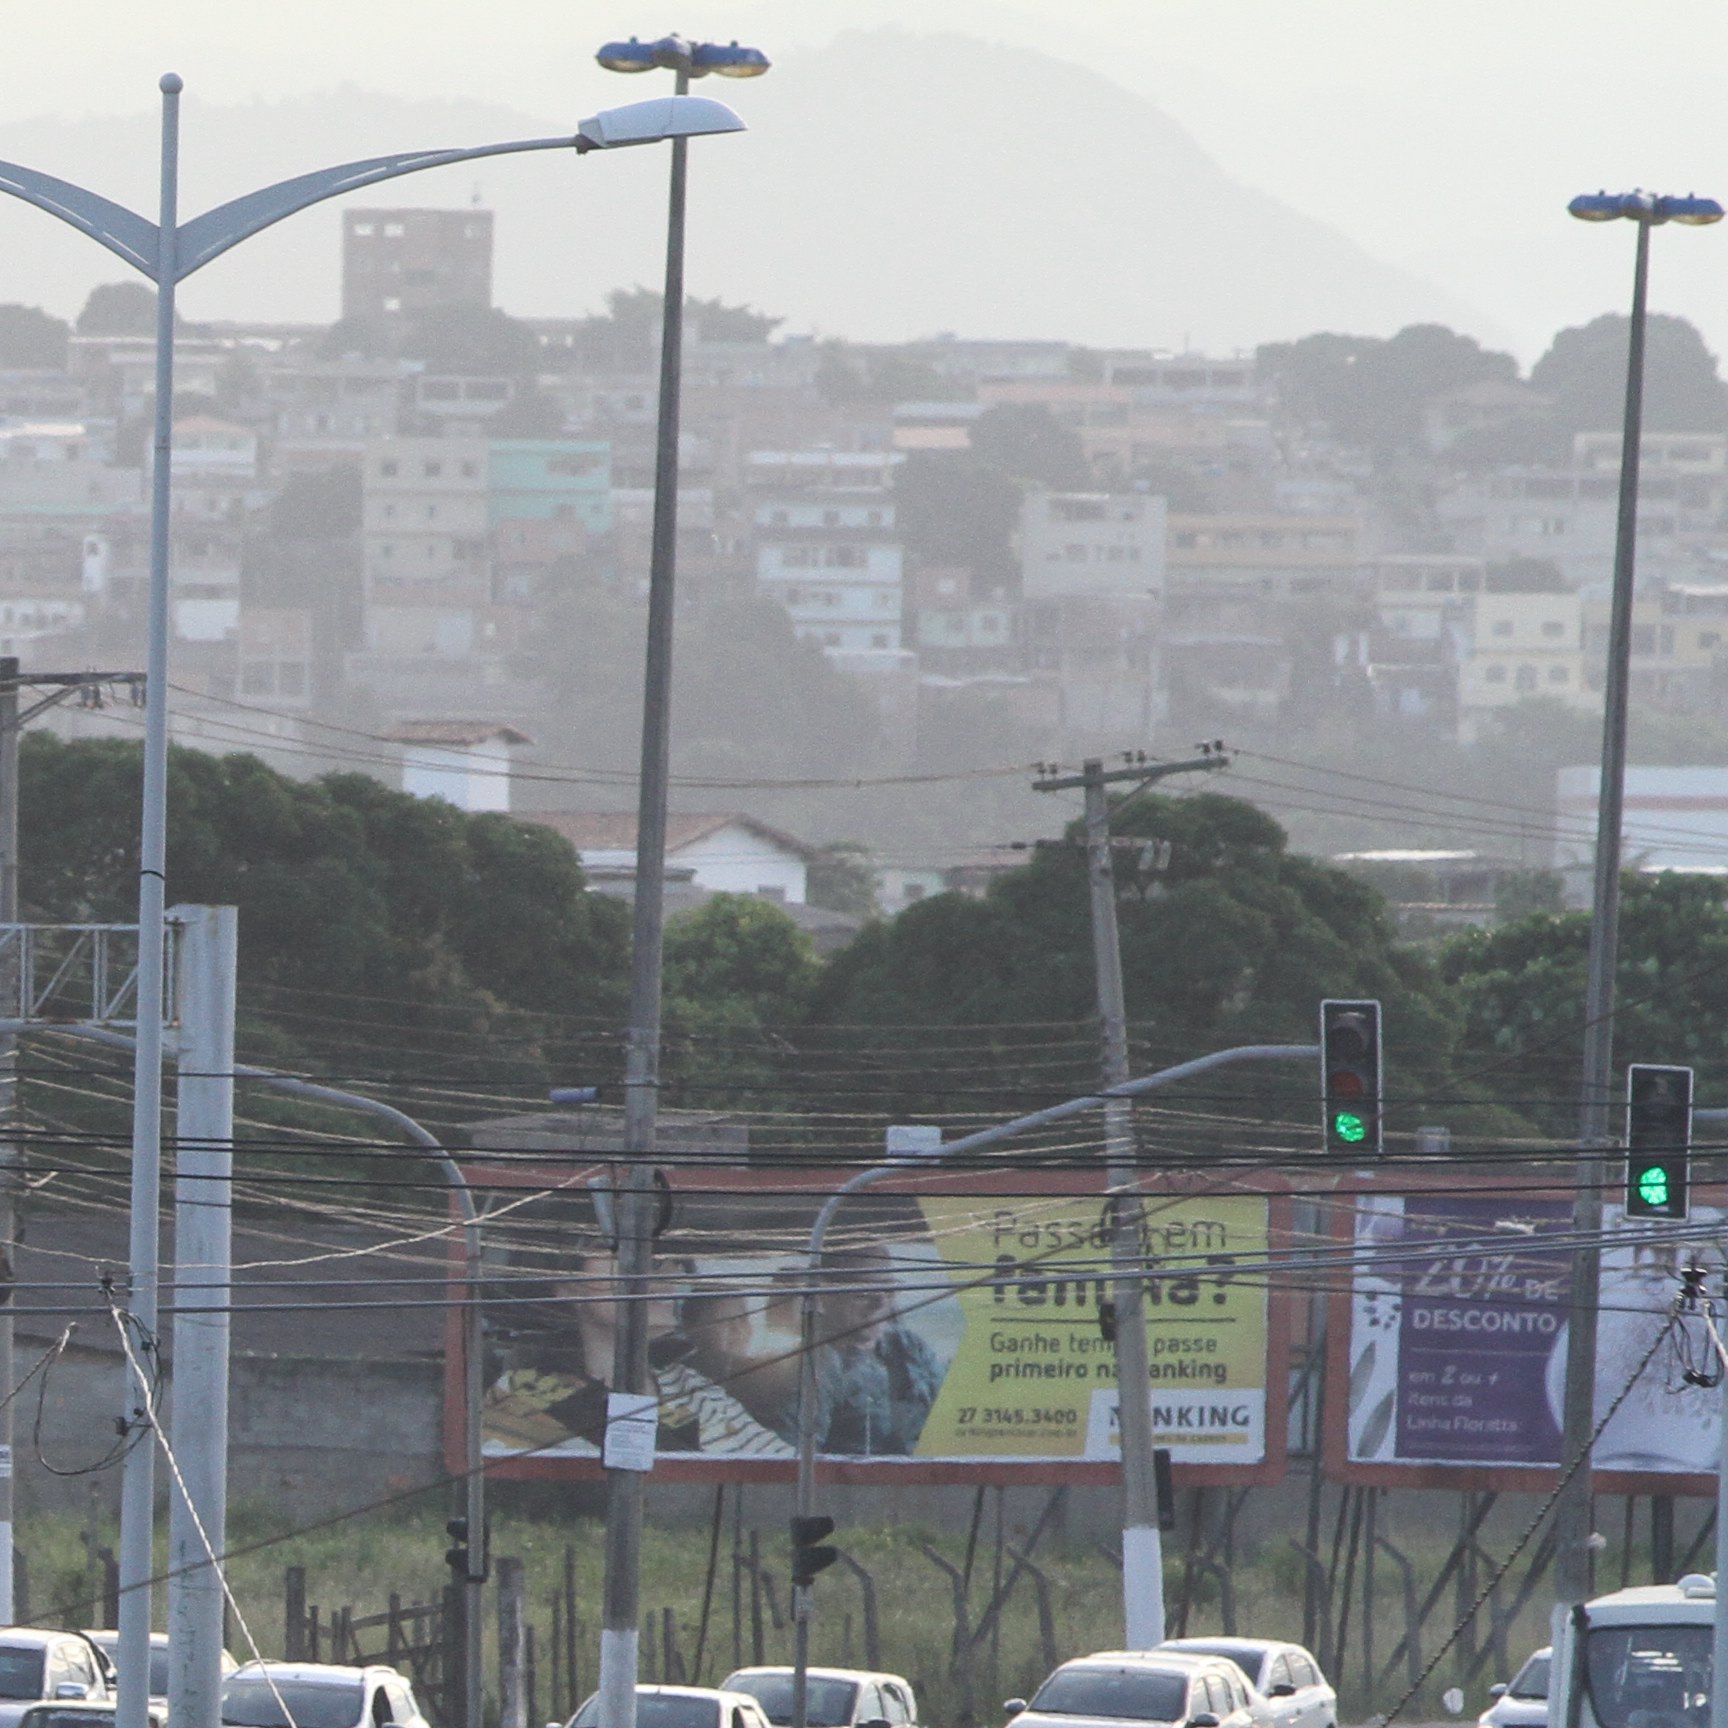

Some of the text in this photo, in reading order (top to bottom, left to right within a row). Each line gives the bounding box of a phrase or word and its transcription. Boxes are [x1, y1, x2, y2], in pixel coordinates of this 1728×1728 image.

[1165, 1220, 1226, 1249] em
[1525, 1280, 1559, 1302] DE
[1413, 1308, 1558, 1333] DESCONTO
[990, 1333, 1061, 1354] Ganhe
[1152, 1336, 1217, 1360] passe
[990, 1358, 1087, 1382] primeiro
[1149, 1358, 1228, 1385] anking
[1440, 1365, 1458, 1385] 2
[958, 1408, 975, 1424] 27
